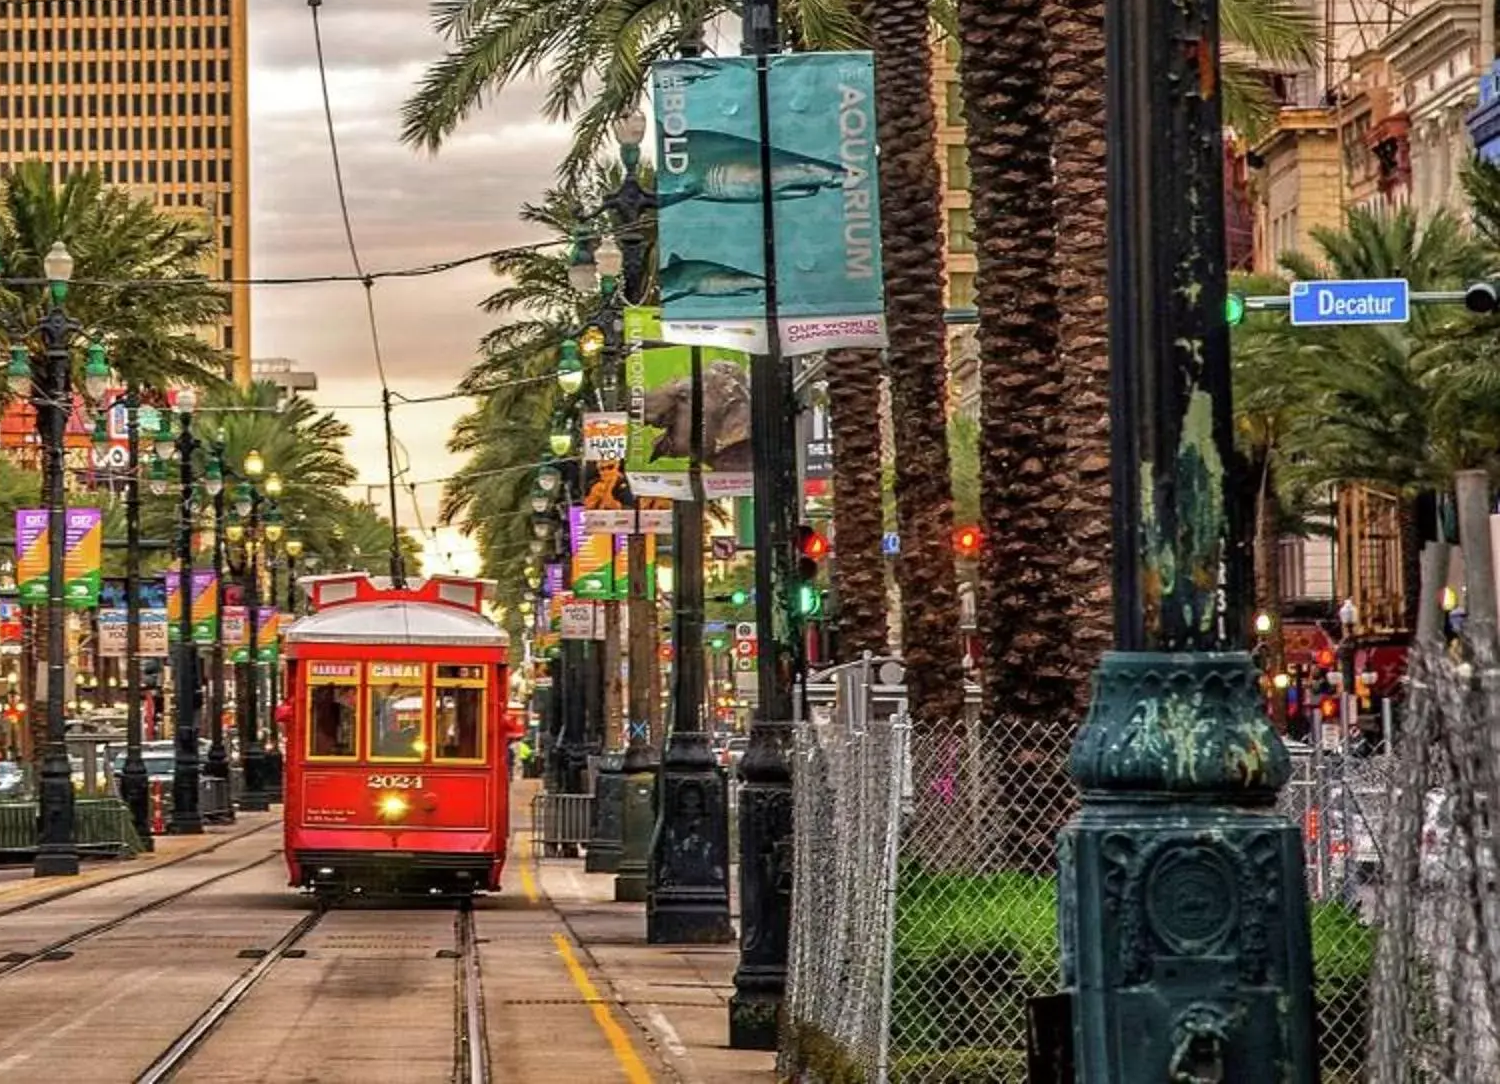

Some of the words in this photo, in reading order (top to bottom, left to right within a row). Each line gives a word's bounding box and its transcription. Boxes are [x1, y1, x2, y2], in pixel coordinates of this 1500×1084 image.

[663, 93, 689, 174] BOLD
[837, 83, 874, 280] AQUARIUM
[1318, 289, 1395, 316] Decatur
